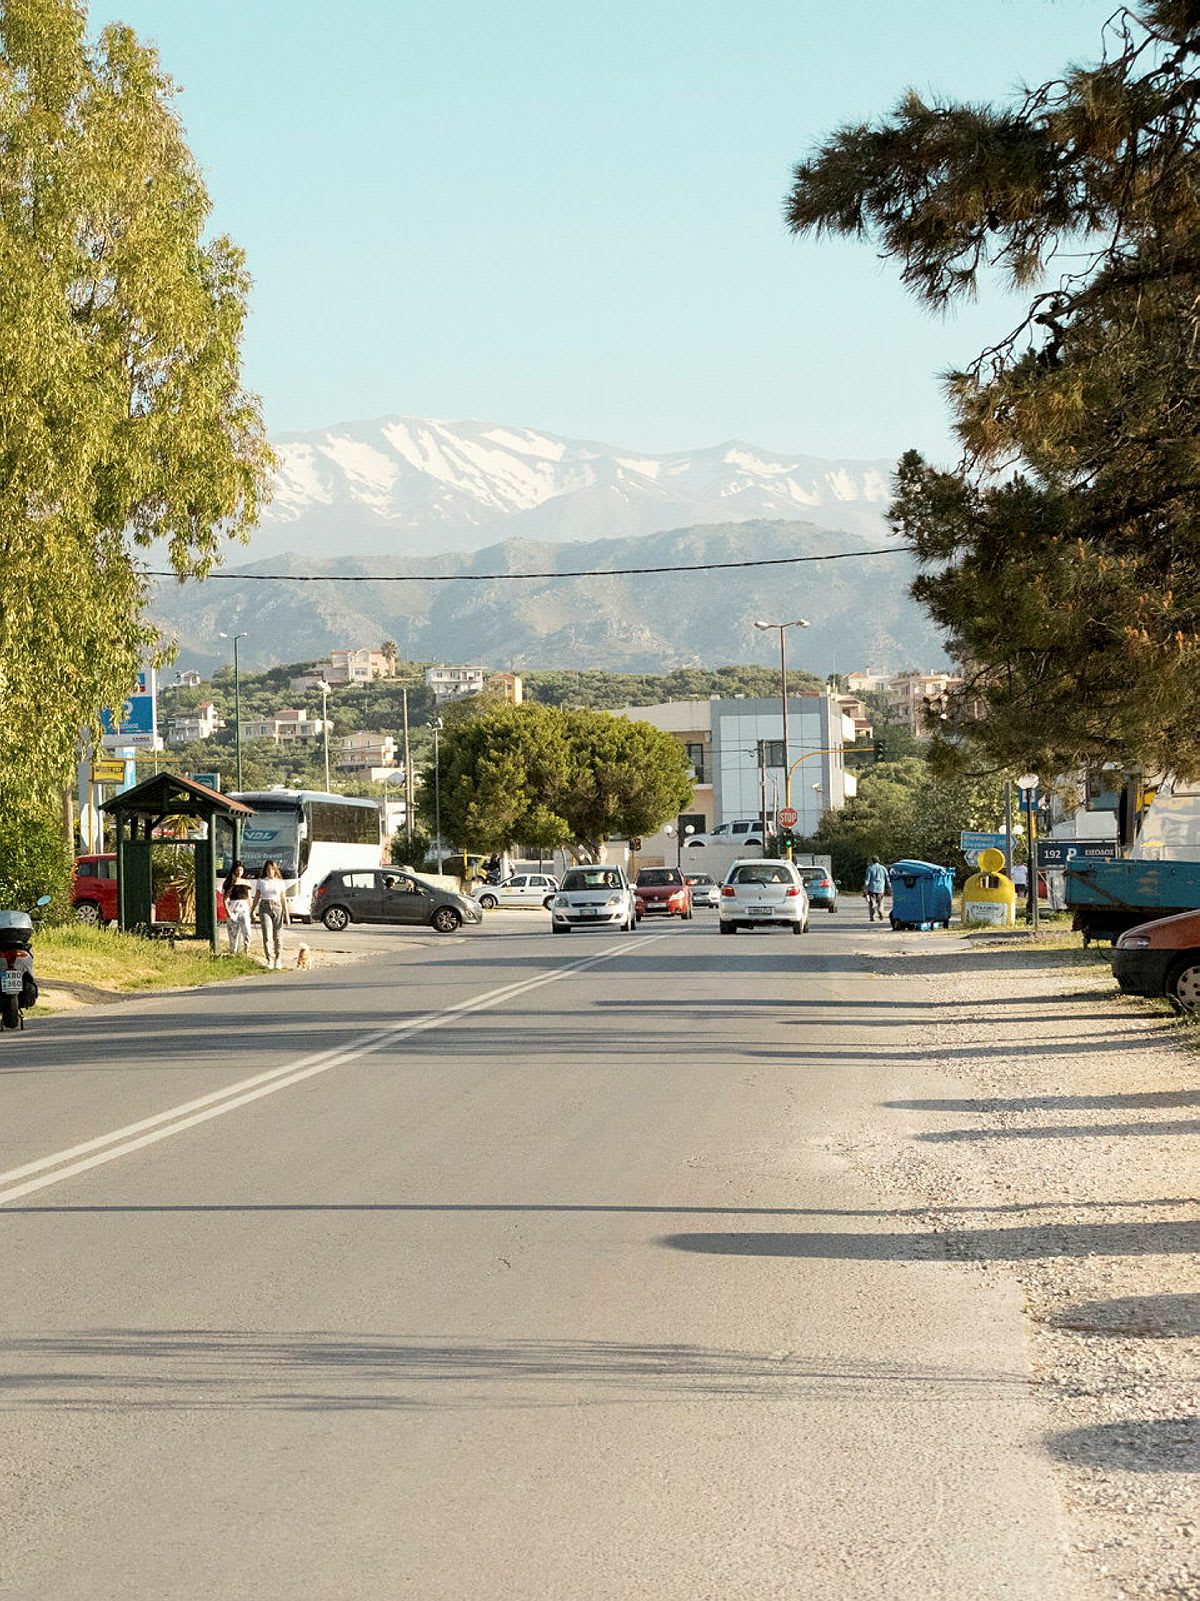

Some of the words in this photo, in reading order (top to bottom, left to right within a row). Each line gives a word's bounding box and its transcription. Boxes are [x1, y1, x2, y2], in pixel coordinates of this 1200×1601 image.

[779, 812, 797, 823] STOP
[244, 832, 272, 840] VDL
[1044, 849, 1061, 859] 192
